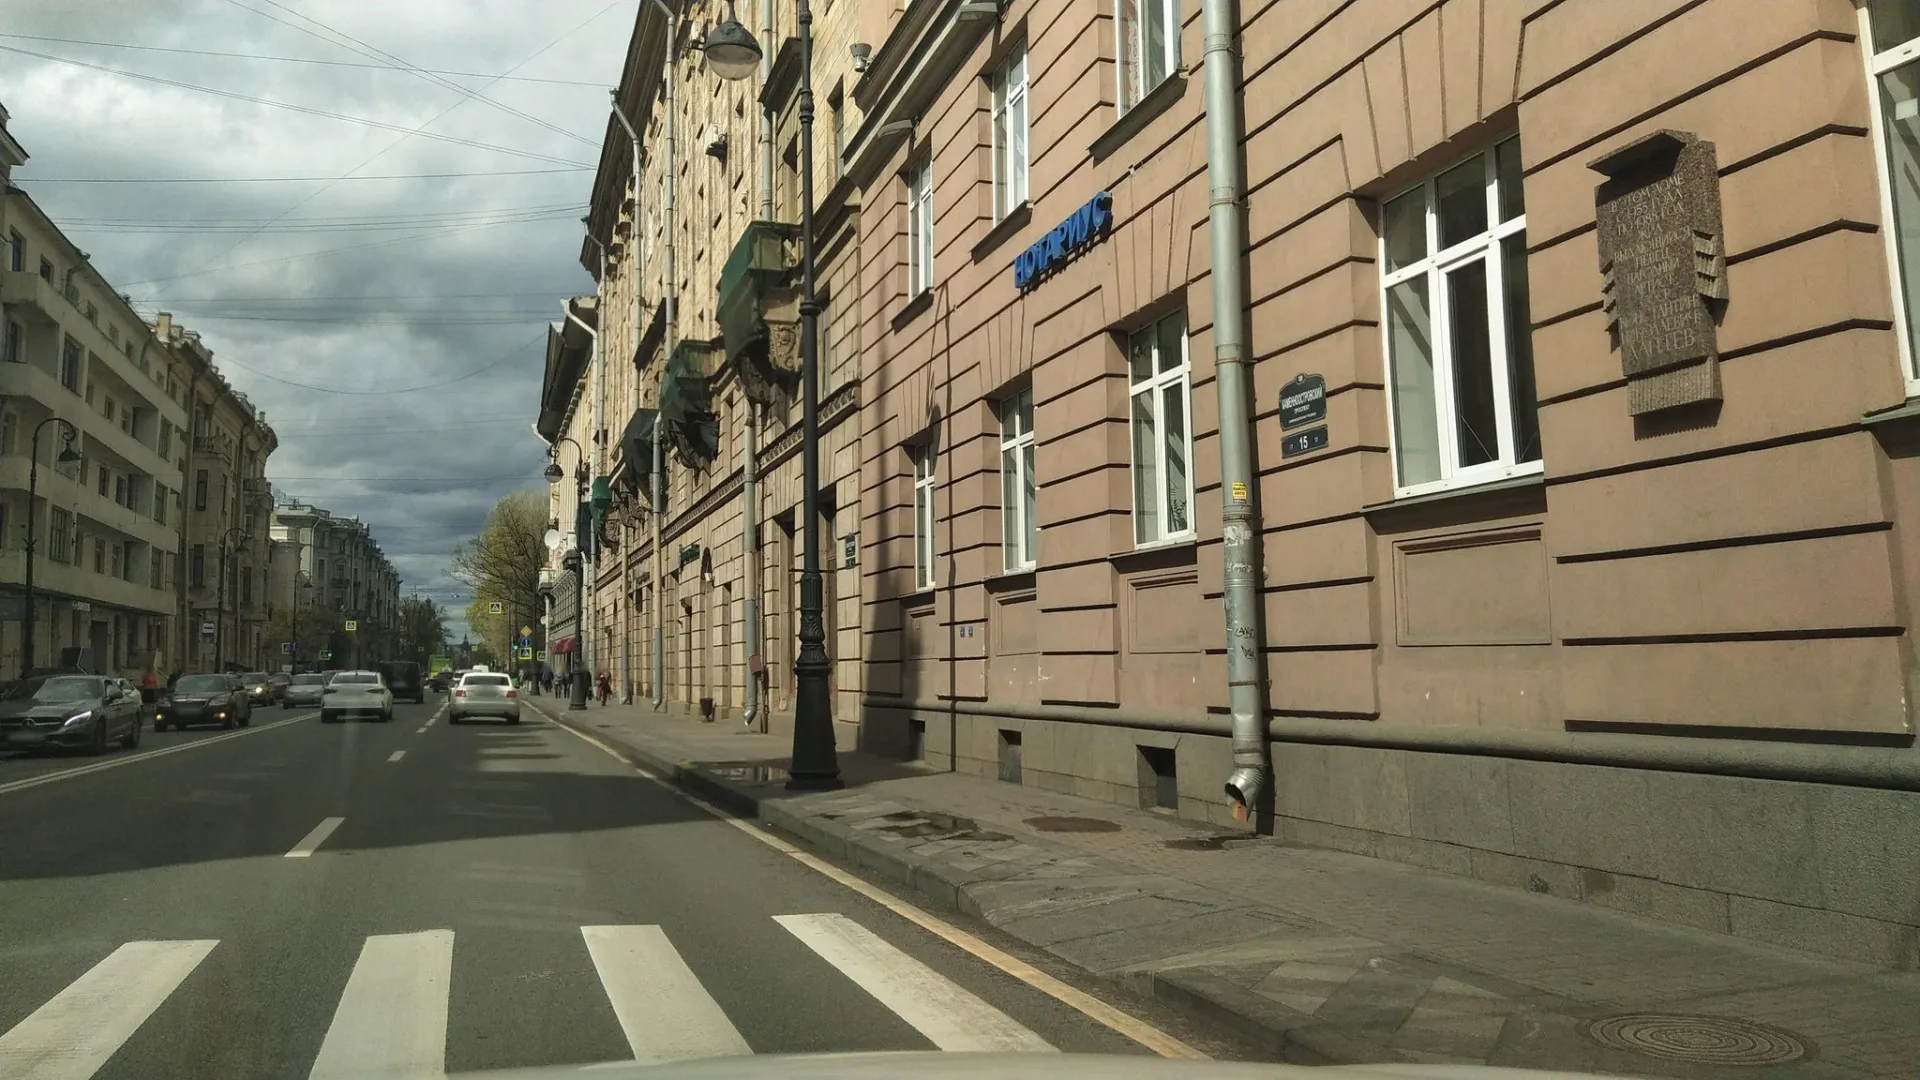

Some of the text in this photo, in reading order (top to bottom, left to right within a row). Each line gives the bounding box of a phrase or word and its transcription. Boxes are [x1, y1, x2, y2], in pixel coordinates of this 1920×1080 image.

[1651, 173, 1685, 195] ДОМЕ
[1014, 191, 1113, 288] НОТАРИУС
[1299, 435, 1309, 450] 15
